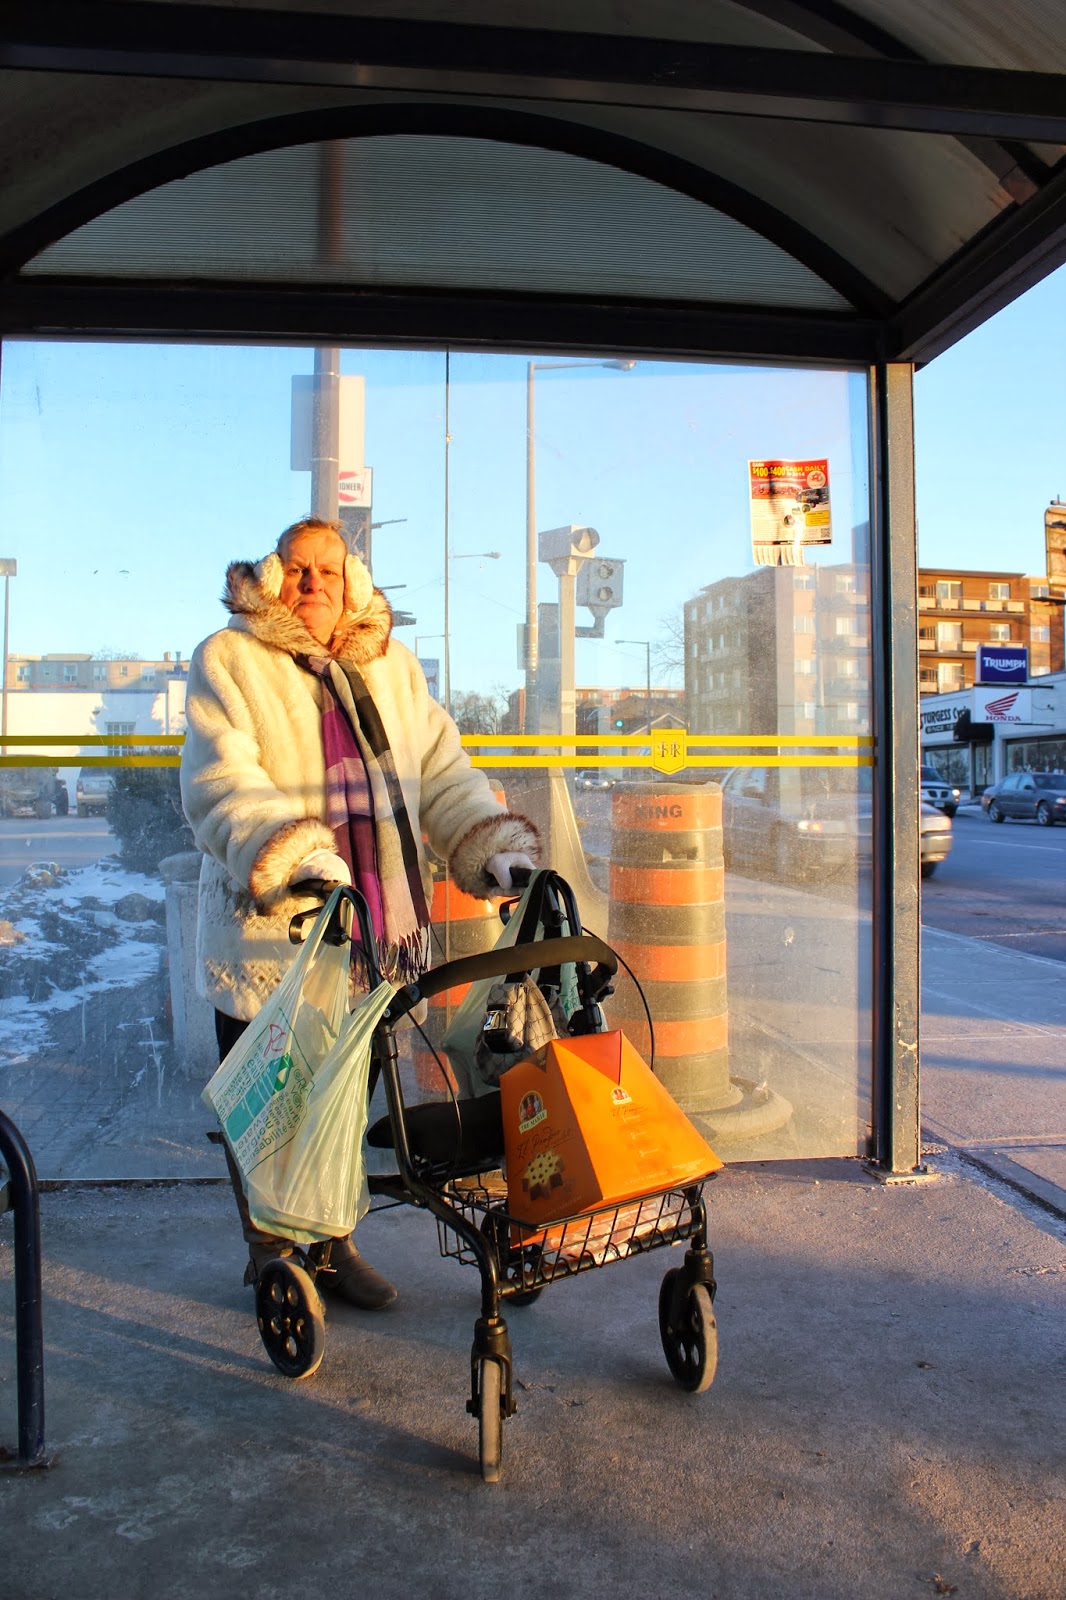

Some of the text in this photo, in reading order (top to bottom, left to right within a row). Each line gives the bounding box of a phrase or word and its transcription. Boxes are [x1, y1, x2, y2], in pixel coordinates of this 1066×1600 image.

[805, 464, 826, 472] DAILY
[339, 482, 361, 491] IONEER
[983, 656, 1026, 671] TRIUMPH
